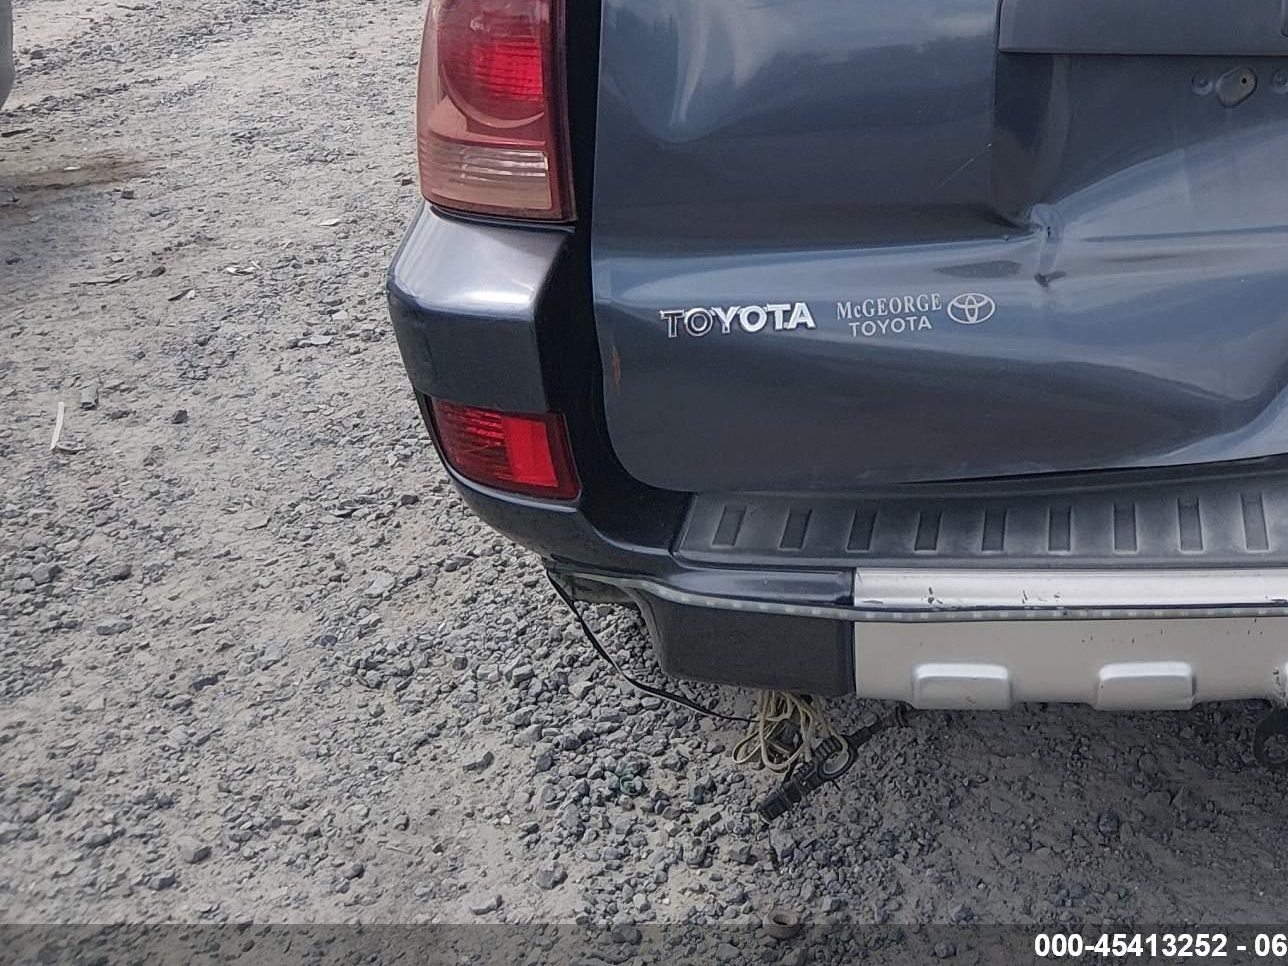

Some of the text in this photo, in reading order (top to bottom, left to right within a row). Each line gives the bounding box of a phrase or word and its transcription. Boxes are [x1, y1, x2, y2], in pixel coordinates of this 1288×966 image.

[660, 302, 816, 338] TOYOTA
[836, 293, 942, 321] McGEORGE
[848, 316, 932, 337] TOYOTA
